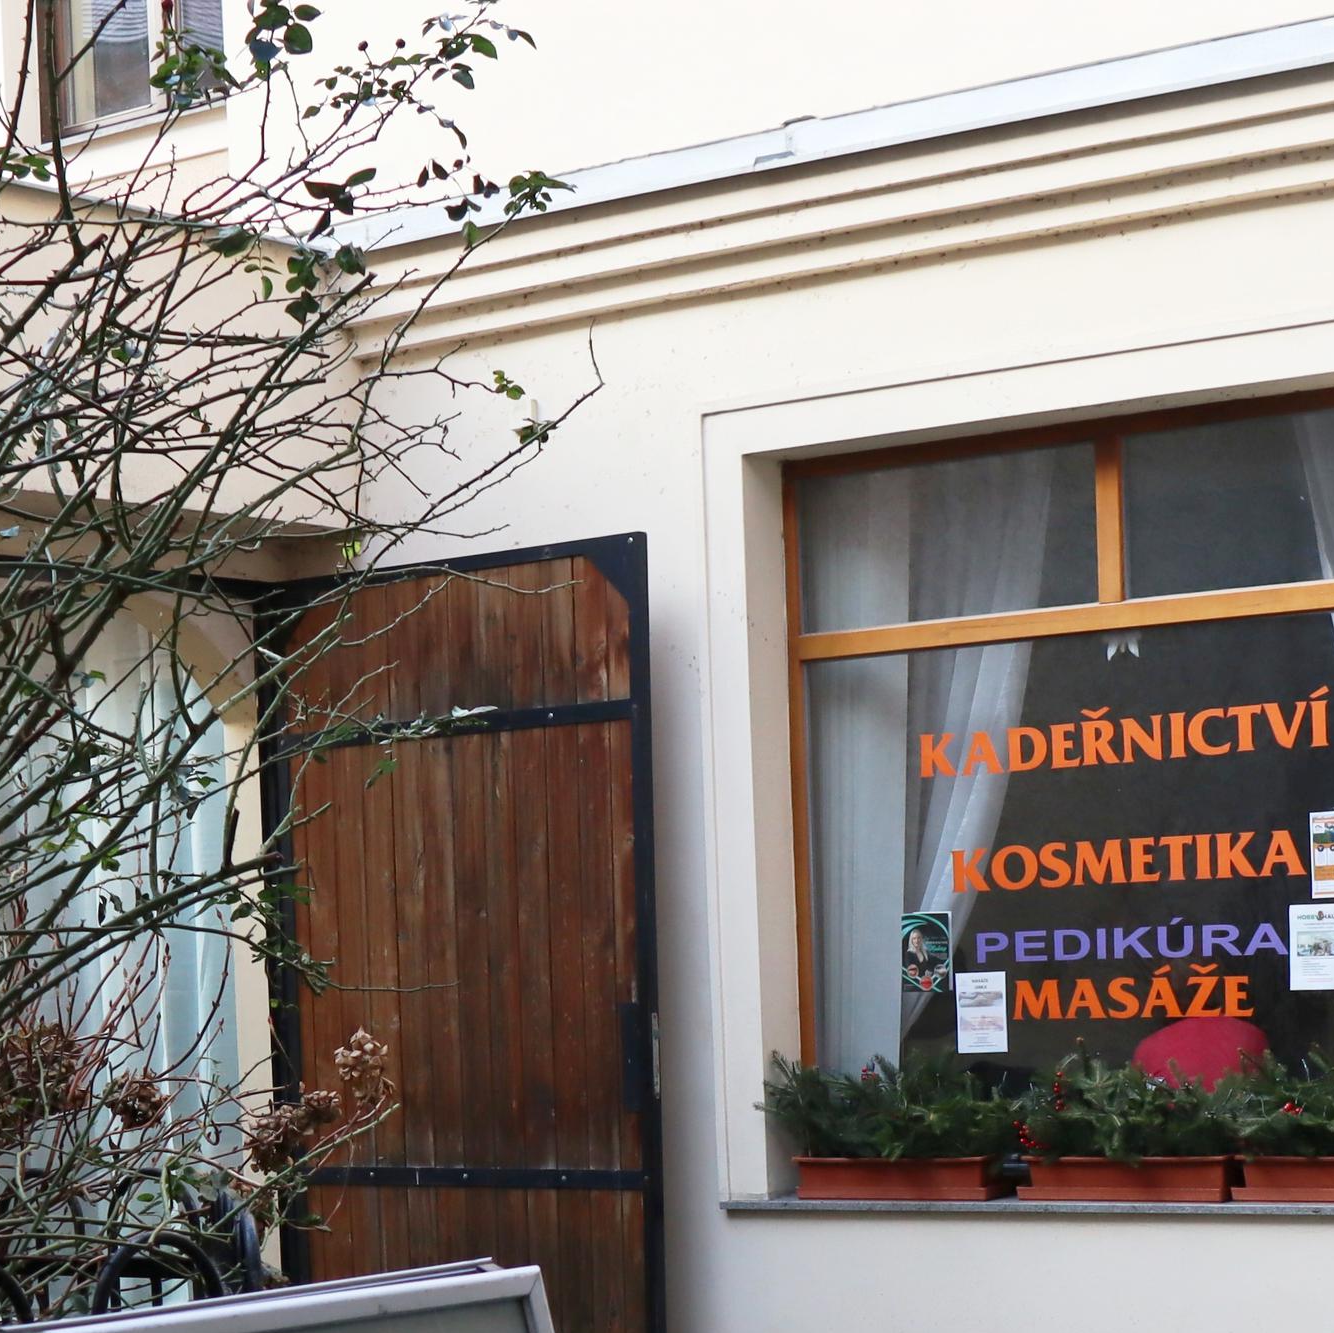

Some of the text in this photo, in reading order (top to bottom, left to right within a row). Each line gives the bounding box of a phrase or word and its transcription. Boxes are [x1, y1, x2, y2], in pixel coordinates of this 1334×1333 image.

[919, 685, 1331, 779] KADEŘNICTVÍ
[951, 829, 1307, 894] KOSMETIKA
[975, 917, 1289, 964] PEDIKÚRA
[1012, 963, 1255, 1021] MASÁŽE
